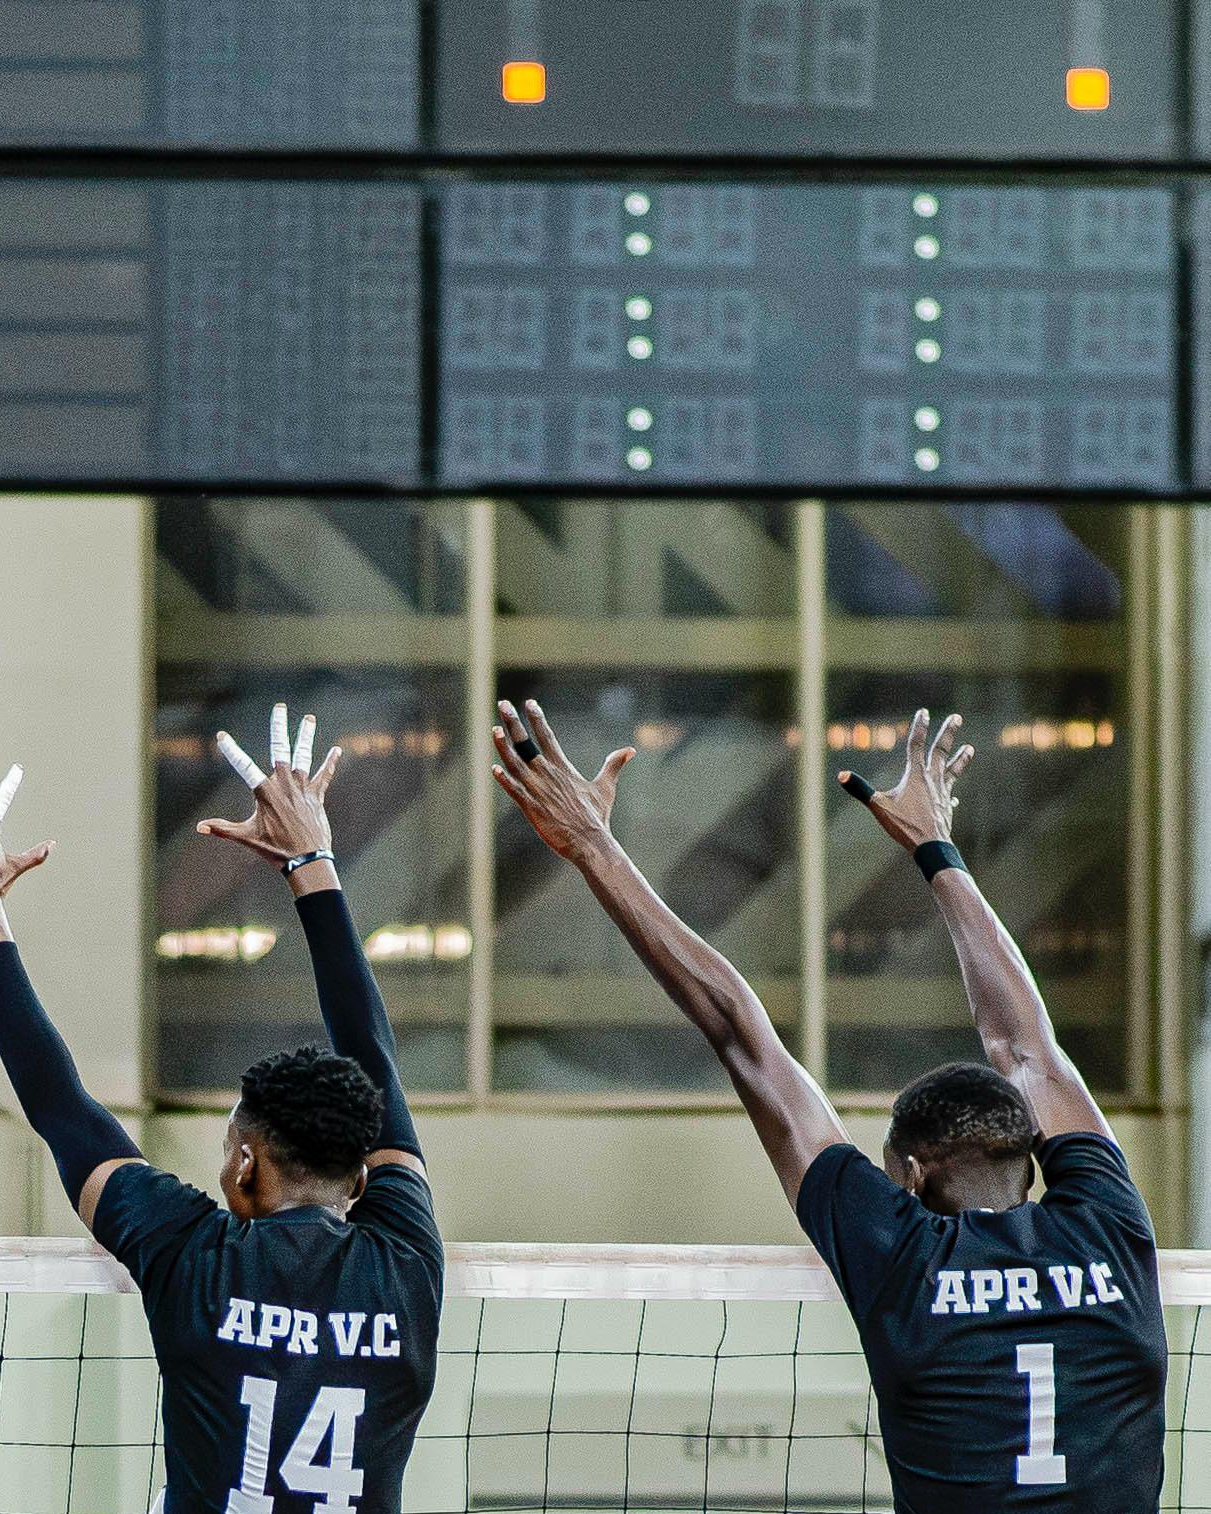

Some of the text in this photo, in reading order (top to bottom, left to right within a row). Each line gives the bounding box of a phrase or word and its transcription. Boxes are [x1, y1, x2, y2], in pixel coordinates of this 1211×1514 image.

[932, 1262, 1123, 1313] APR V.C
[218, 1298, 401, 1357] APR V.C
[1016, 1343, 1066, 1484] 1
[684, 1423, 773, 1462] EXIT
